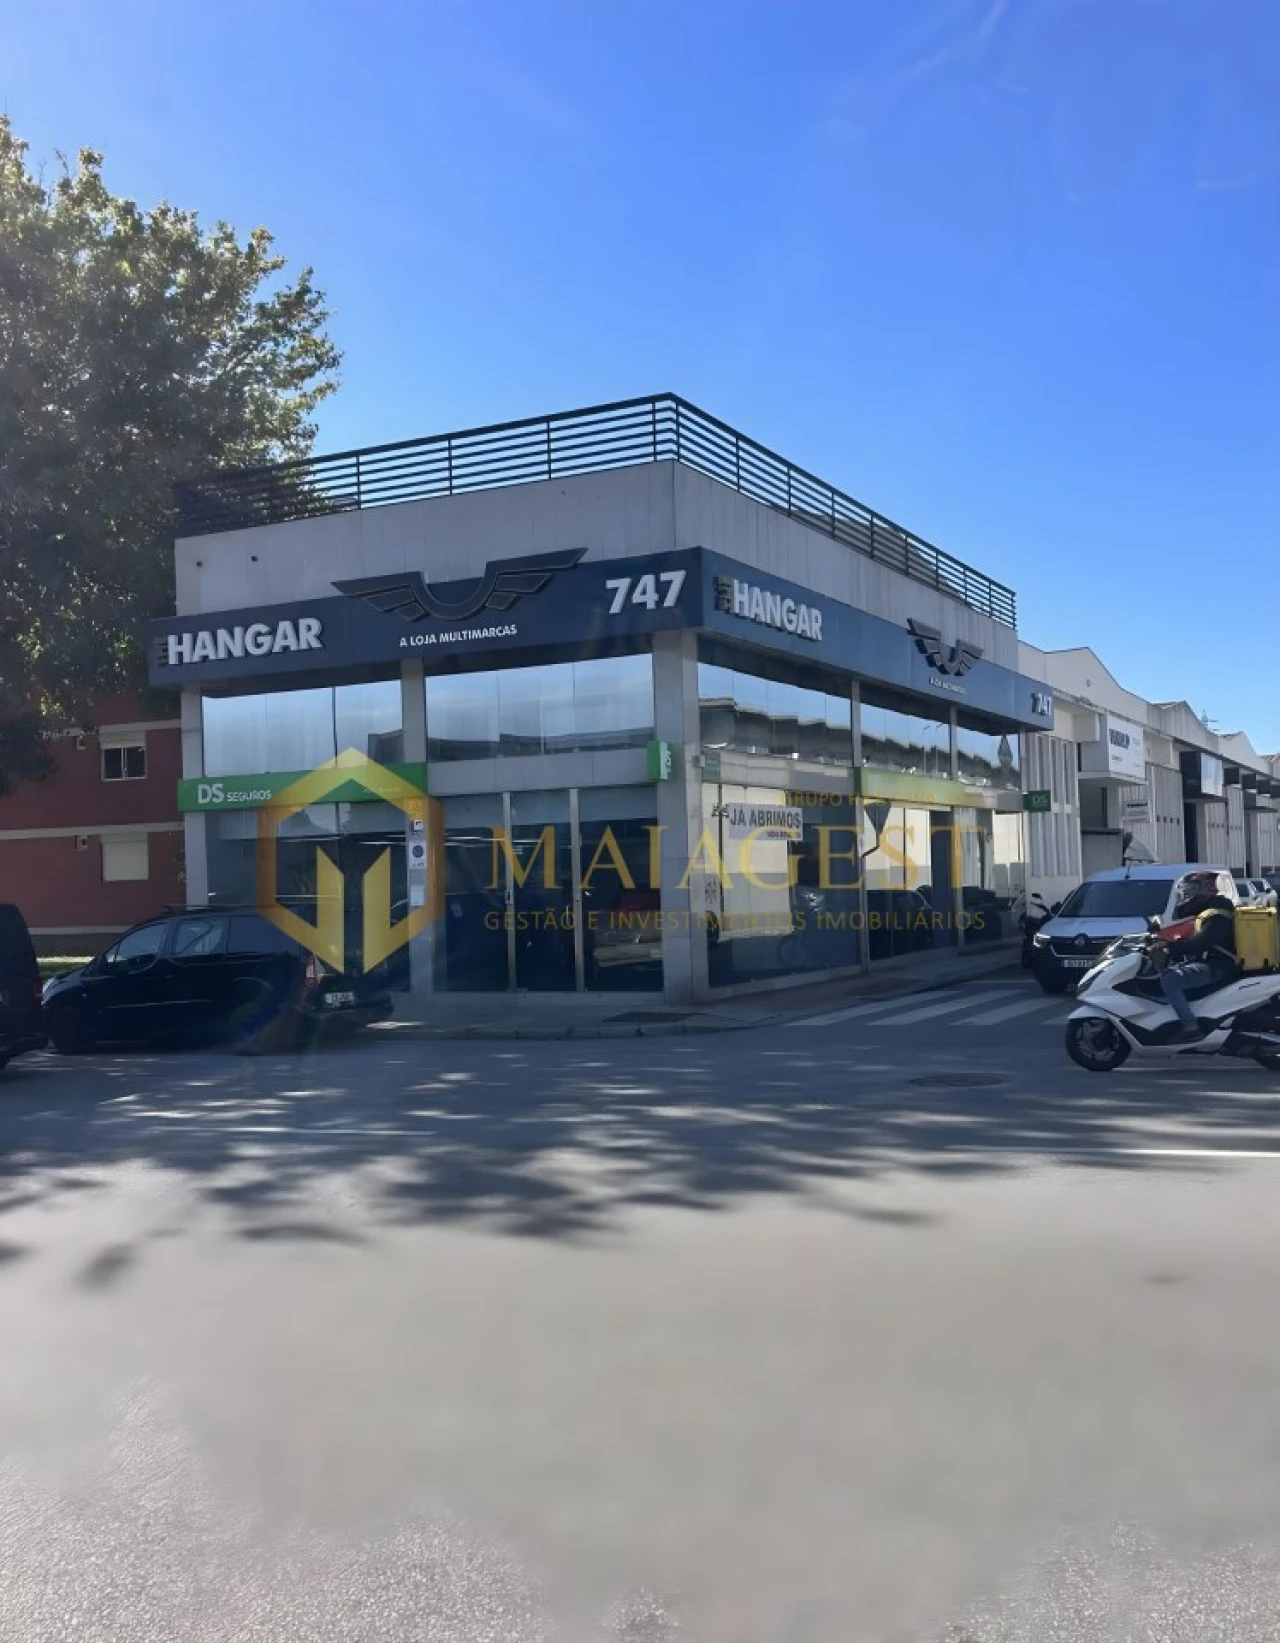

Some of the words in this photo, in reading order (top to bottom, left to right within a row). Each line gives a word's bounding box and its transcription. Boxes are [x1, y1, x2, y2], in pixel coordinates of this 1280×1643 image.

[605, 569, 686, 614] 747
[731, 579, 823, 642] HANGAR
[167, 617, 323, 665] HANGAR
[400, 636, 407, 647] A
[410, 631, 437, 646] LOJA
[439, 624, 518, 643] MULTIMARCAS
[197, 783, 224, 804] DS
[227, 790, 272, 802] SEGUROS
[730, 803, 746, 826] JÁ
[749, 808, 800, 829] ABRIMOS
